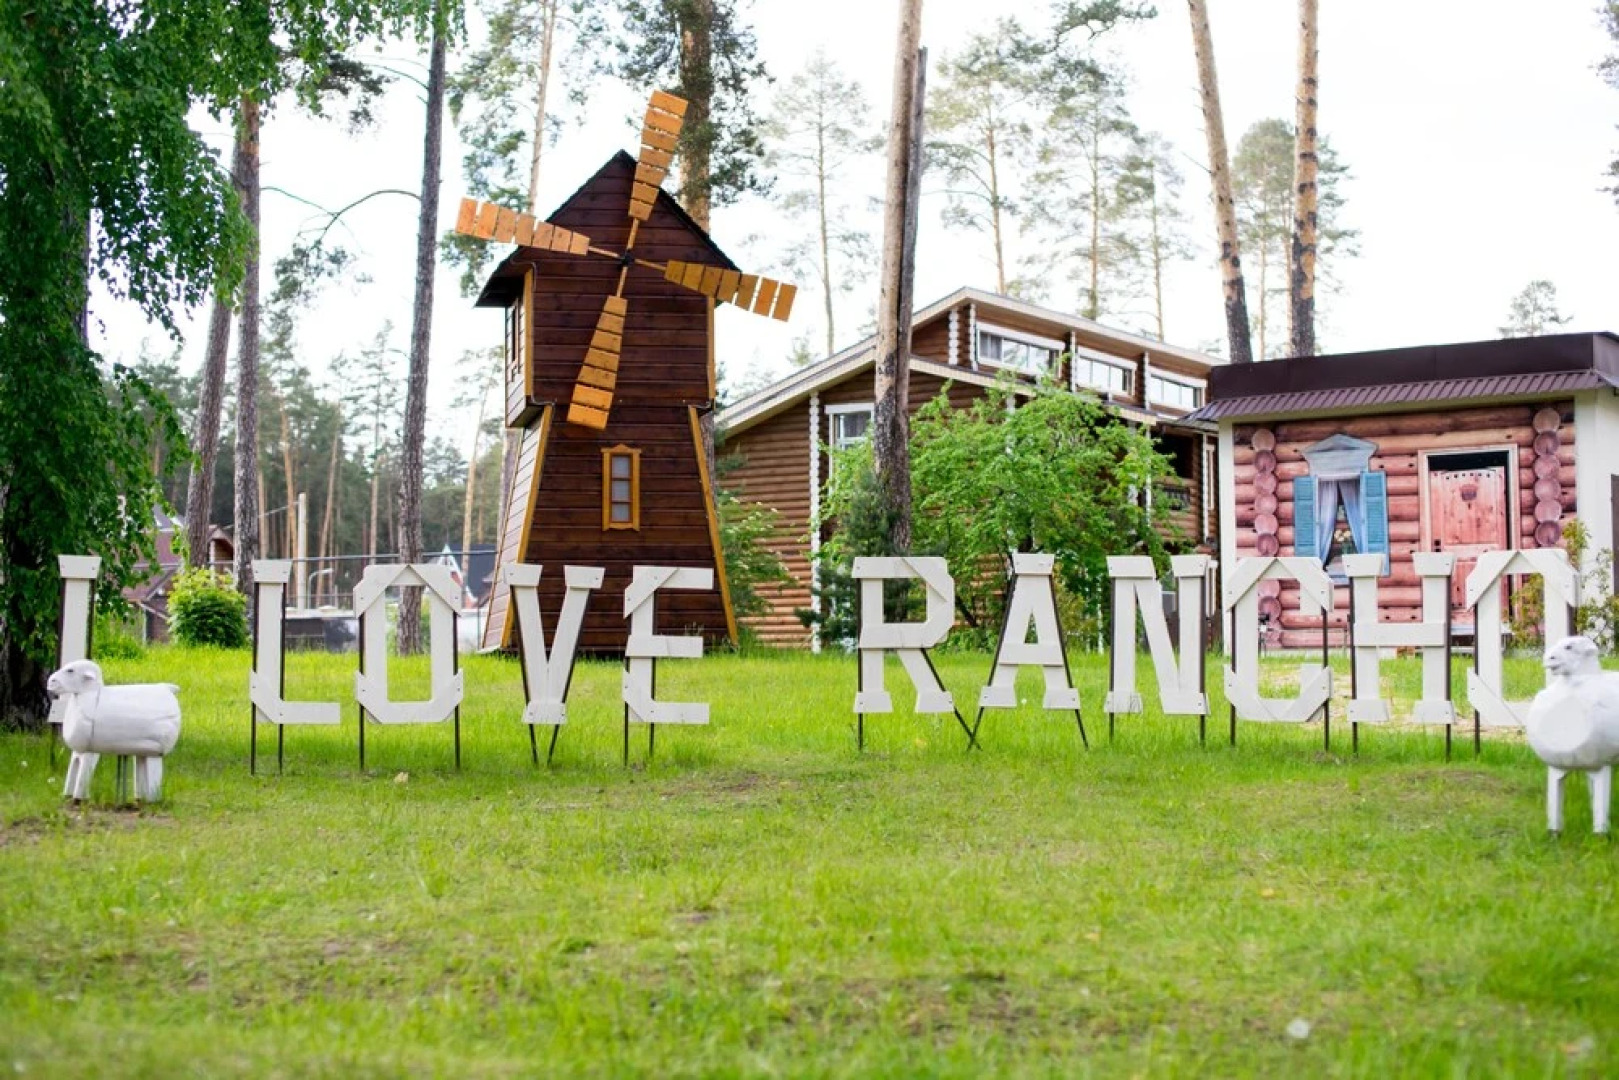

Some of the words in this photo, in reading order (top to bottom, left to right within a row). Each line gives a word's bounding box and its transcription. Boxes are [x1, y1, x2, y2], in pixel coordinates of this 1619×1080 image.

[50, 555, 101, 722] I
[250, 559, 713, 725] LOVE
[853, 549, 1579, 726] RANCHO
